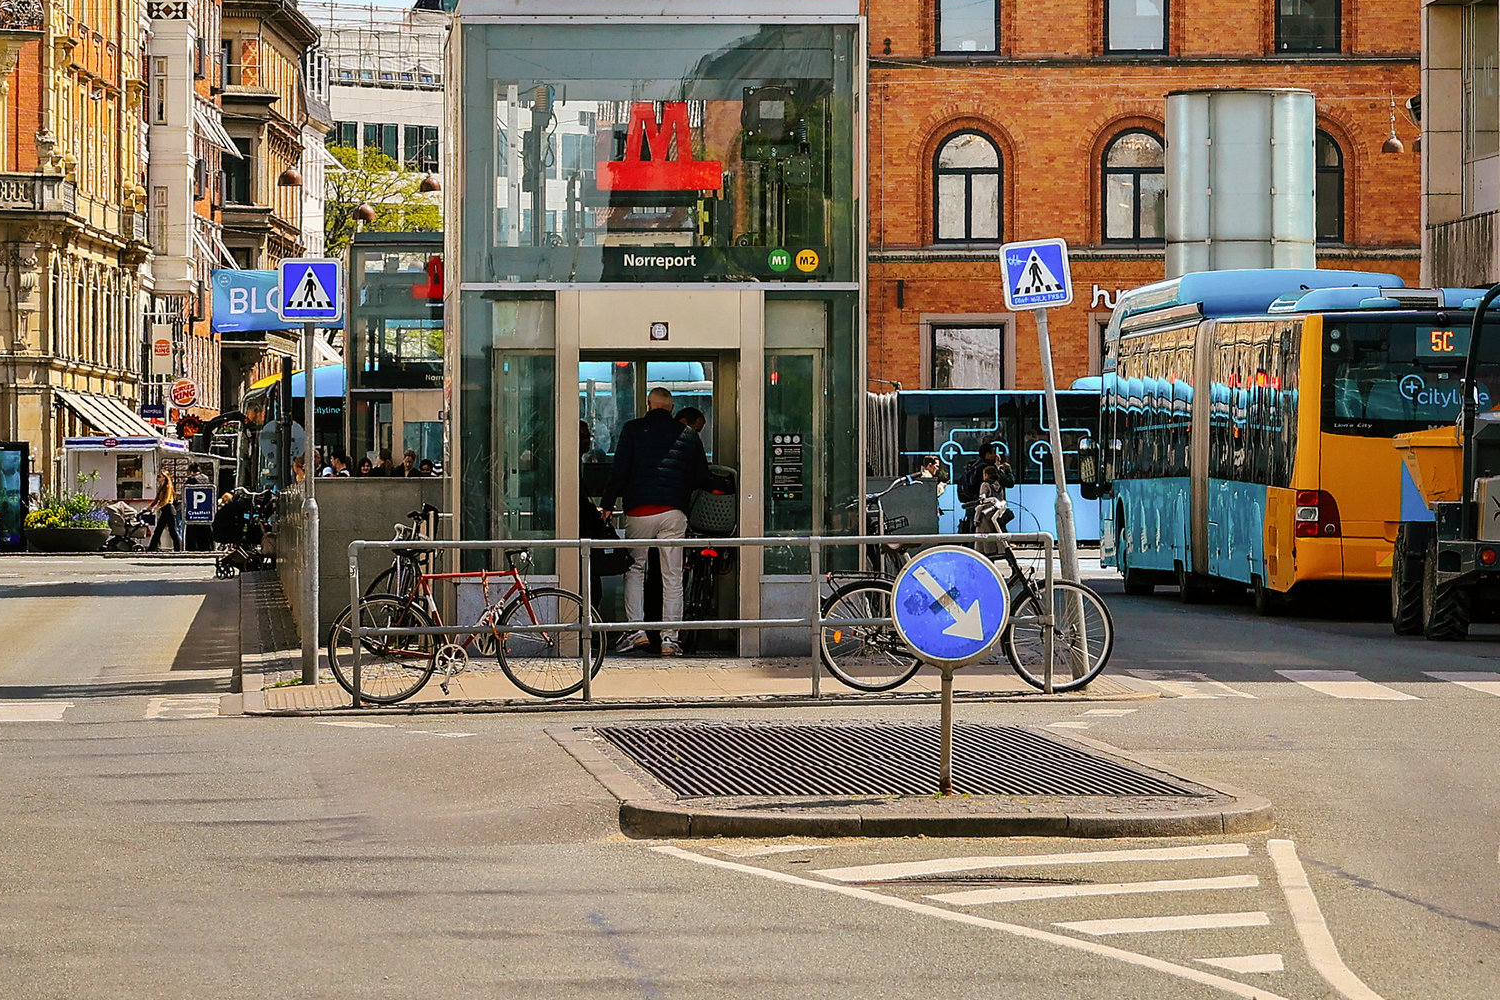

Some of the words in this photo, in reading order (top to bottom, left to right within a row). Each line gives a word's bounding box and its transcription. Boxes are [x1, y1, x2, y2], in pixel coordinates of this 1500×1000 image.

[623, 254, 697, 269] Nørreport
[771, 255, 787, 266] M1
[799, 255, 816, 266] M2
[1430, 330, 1455, 352] 5C
[173, 389, 196, 402] KING
[1417, 387, 1490, 408] citylie
[193, 491, 206, 509] P
